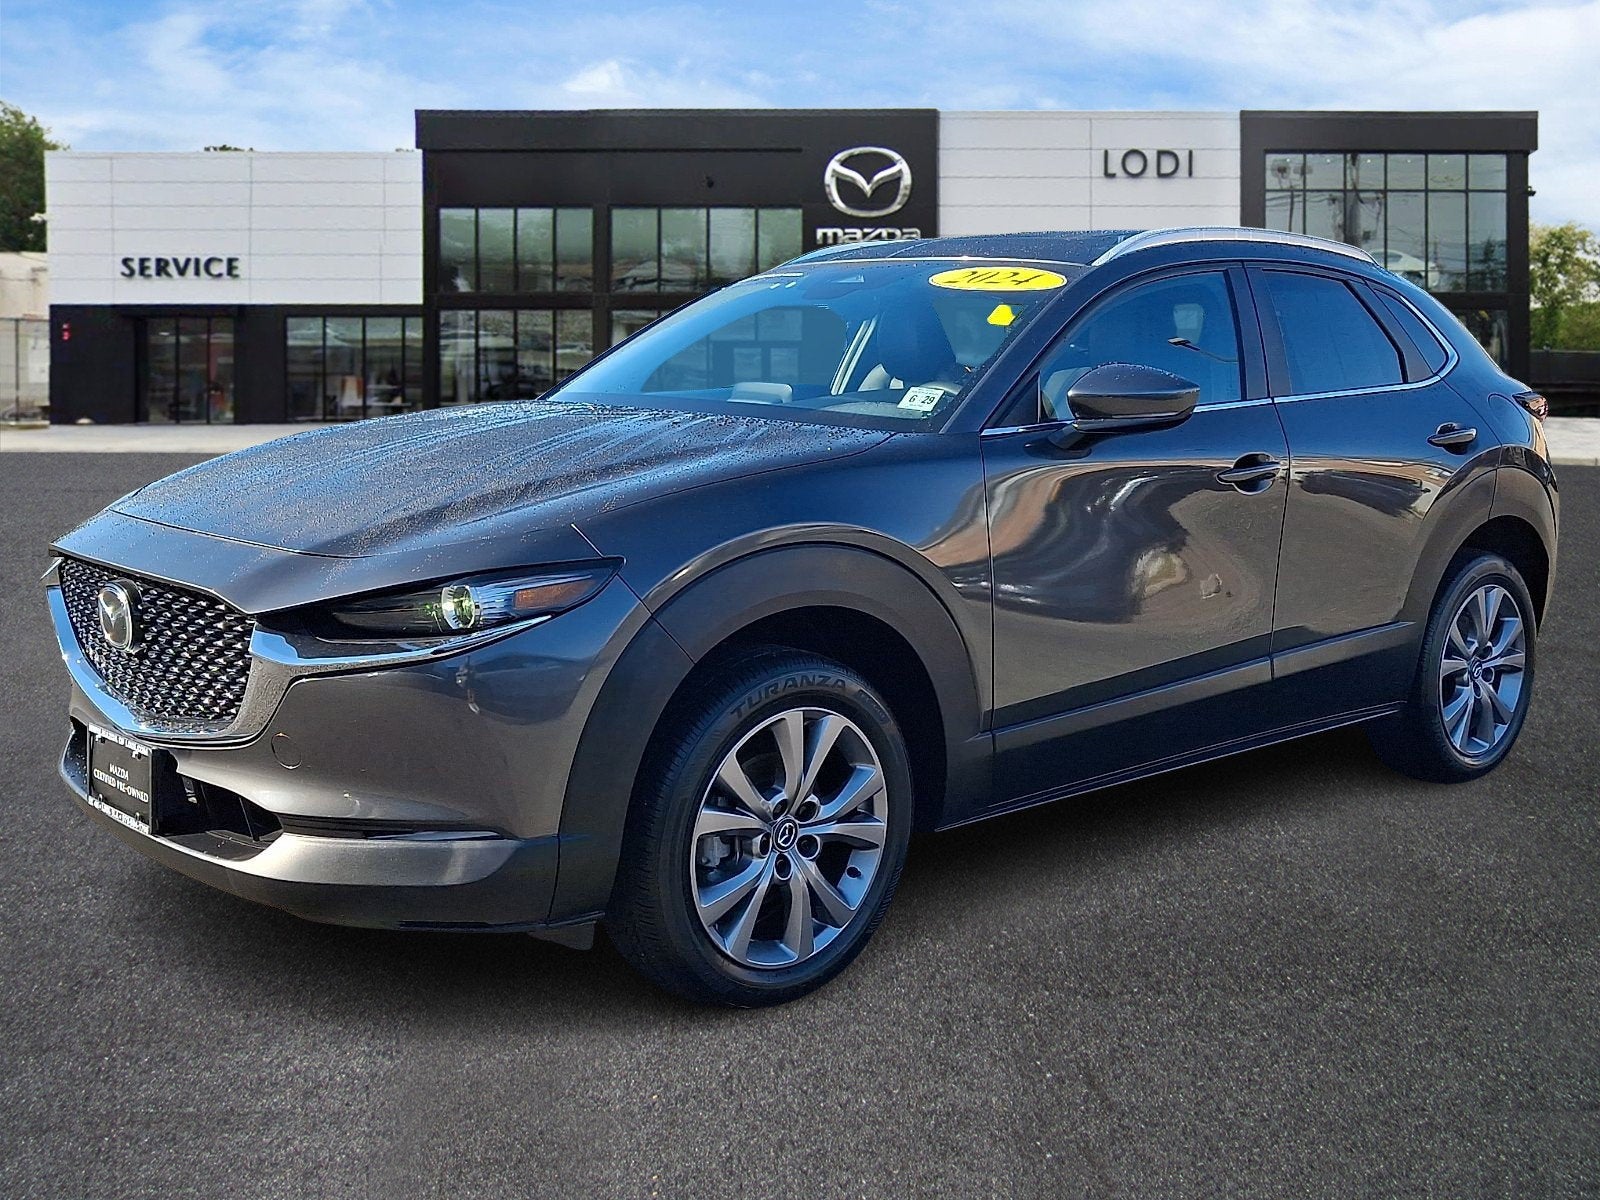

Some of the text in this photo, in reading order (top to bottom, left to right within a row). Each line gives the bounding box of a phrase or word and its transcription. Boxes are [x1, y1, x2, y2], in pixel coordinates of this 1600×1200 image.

[1103, 149, 1193, 178] LODI
[120, 256, 240, 278] SERVICE
[730, 674, 847, 719] TURANZA
[93, 767, 149, 803] CERTIFIED PRE-OWNED
[109, 762, 129, 781] MAZDA
